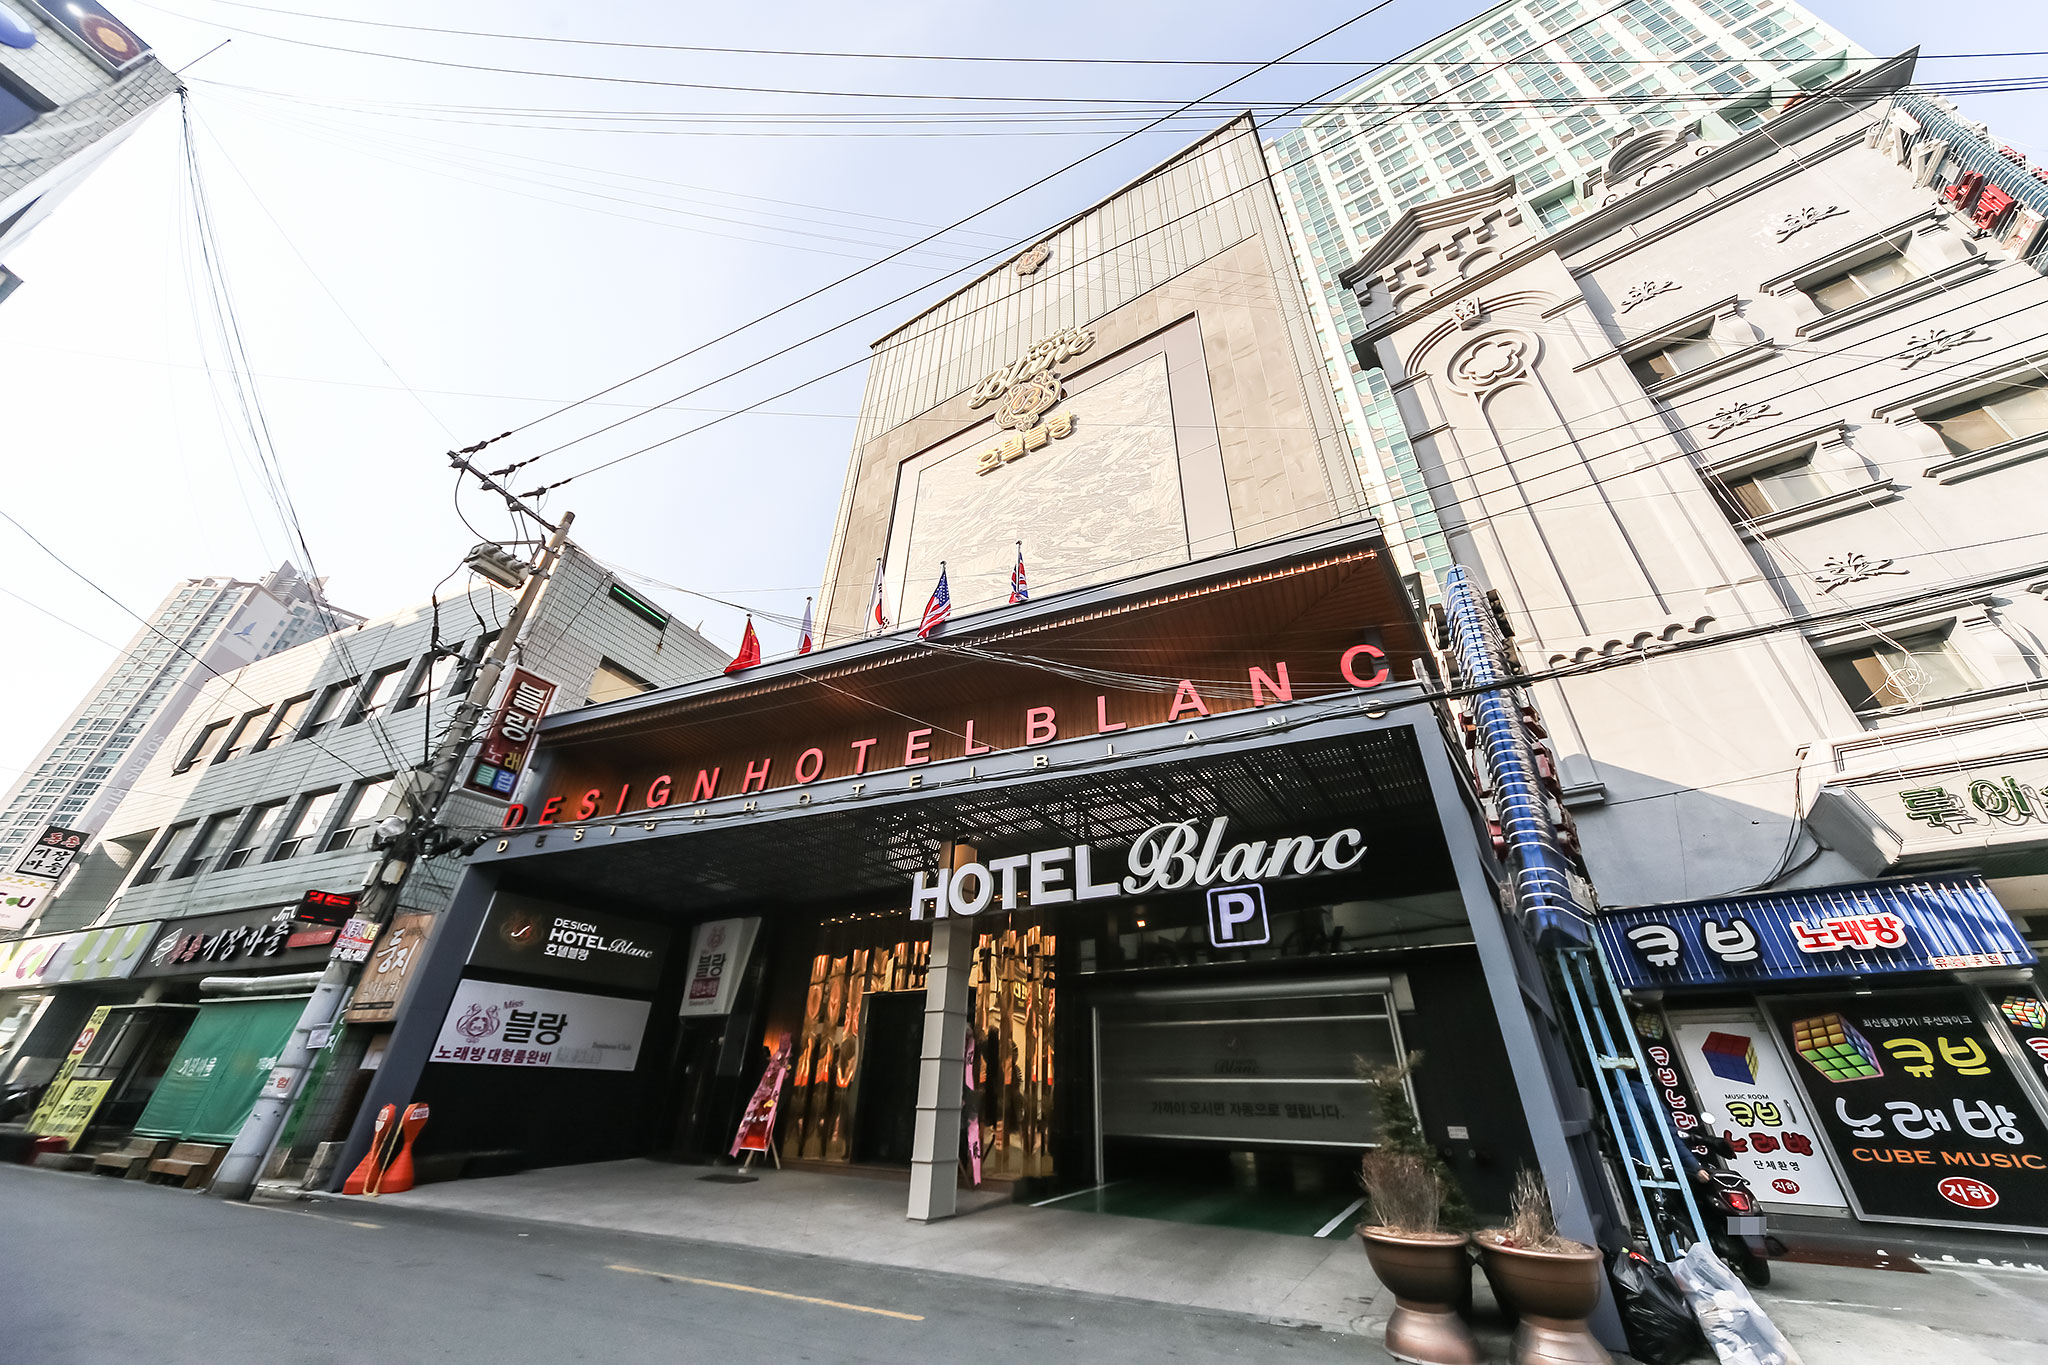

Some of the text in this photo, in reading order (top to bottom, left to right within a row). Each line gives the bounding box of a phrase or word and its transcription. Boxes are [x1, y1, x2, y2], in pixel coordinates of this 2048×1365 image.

[967, 330, 1095, 408] Blanc
[975, 411, 1073, 475] 호텔블랑
[26, 860, 63, 873] 마을
[34, 848, 71, 861] 기장
[909, 816, 1368, 921] HOTEL Blanc
[553, 918, 597, 933] DESIGN
[203, 921, 290, 961] 기장마을
[544, 943, 590, 962] 호텔블랑
[549, 928, 653, 959] HOTEL Blanc
[1627, 915, 1902, 969] 큐브 노래방
[696, 953, 726, 978] 블랑
[503, 1000, 524, 1010] Miss
[502, 1009, 568, 1045] 블랑
[435, 1045, 487, 1062] 노래방
[487, 1048, 552, 1065] 대형룸완비
[1882, 1036, 1991, 1078] 큐브
[1151, 1100, 1345, 1120] 가까이 오시면 자동으로 열립니다.
[1725, 1101, 1783, 1128] 큐브
[1835, 1097, 2024, 1145] 노래방
[1724, 1130, 1814, 1157] 노래방
[1754, 1160, 1801, 1172] 단체환영
[1852, 1148, 2048, 1170] CUBE MUSIC
[1774, 1180, 1798, 1193] 지하
[1943, 1183, 1990, 1204] 지하
